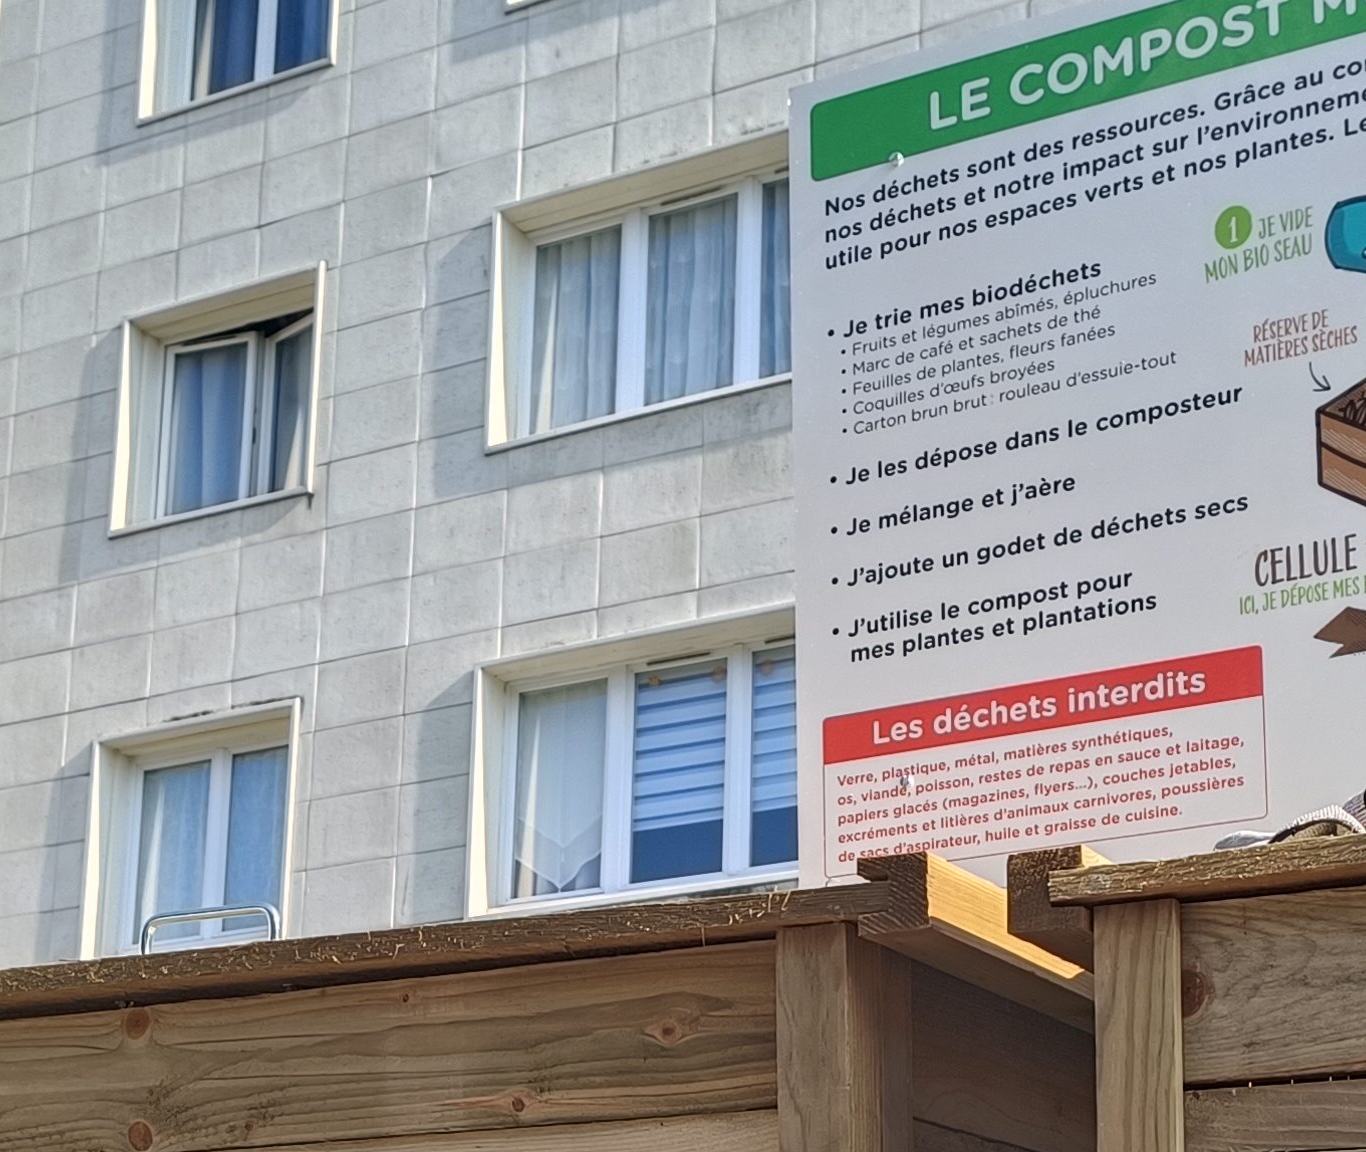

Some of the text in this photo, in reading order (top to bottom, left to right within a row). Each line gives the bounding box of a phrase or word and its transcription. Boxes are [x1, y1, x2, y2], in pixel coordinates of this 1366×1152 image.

[930, 0, 1286, 129] LE COMPOST
[1229, 205, 1313, 243] 1 JE VIDE
[1204, 232, 1312, 284] MON BIO SEAU
[843, 262, 1101, 338] Je trie mes biodéchets
[852, 273, 1156, 356] Fruits et légumes abîmés, épluchures
[845, 387, 1242, 485] Je les dépose dans le composteur
[846, 477, 1075, 536] Je mélange et j’aère
[1254, 533, 1357, 587] CELLULE
[848, 572, 1132, 637] J’utilise le compost pour
[873, 671, 1205, 744] Les déchets interdits
[837, 726, 1172, 786] Verre, plastique, métal, matières synthétiques,
